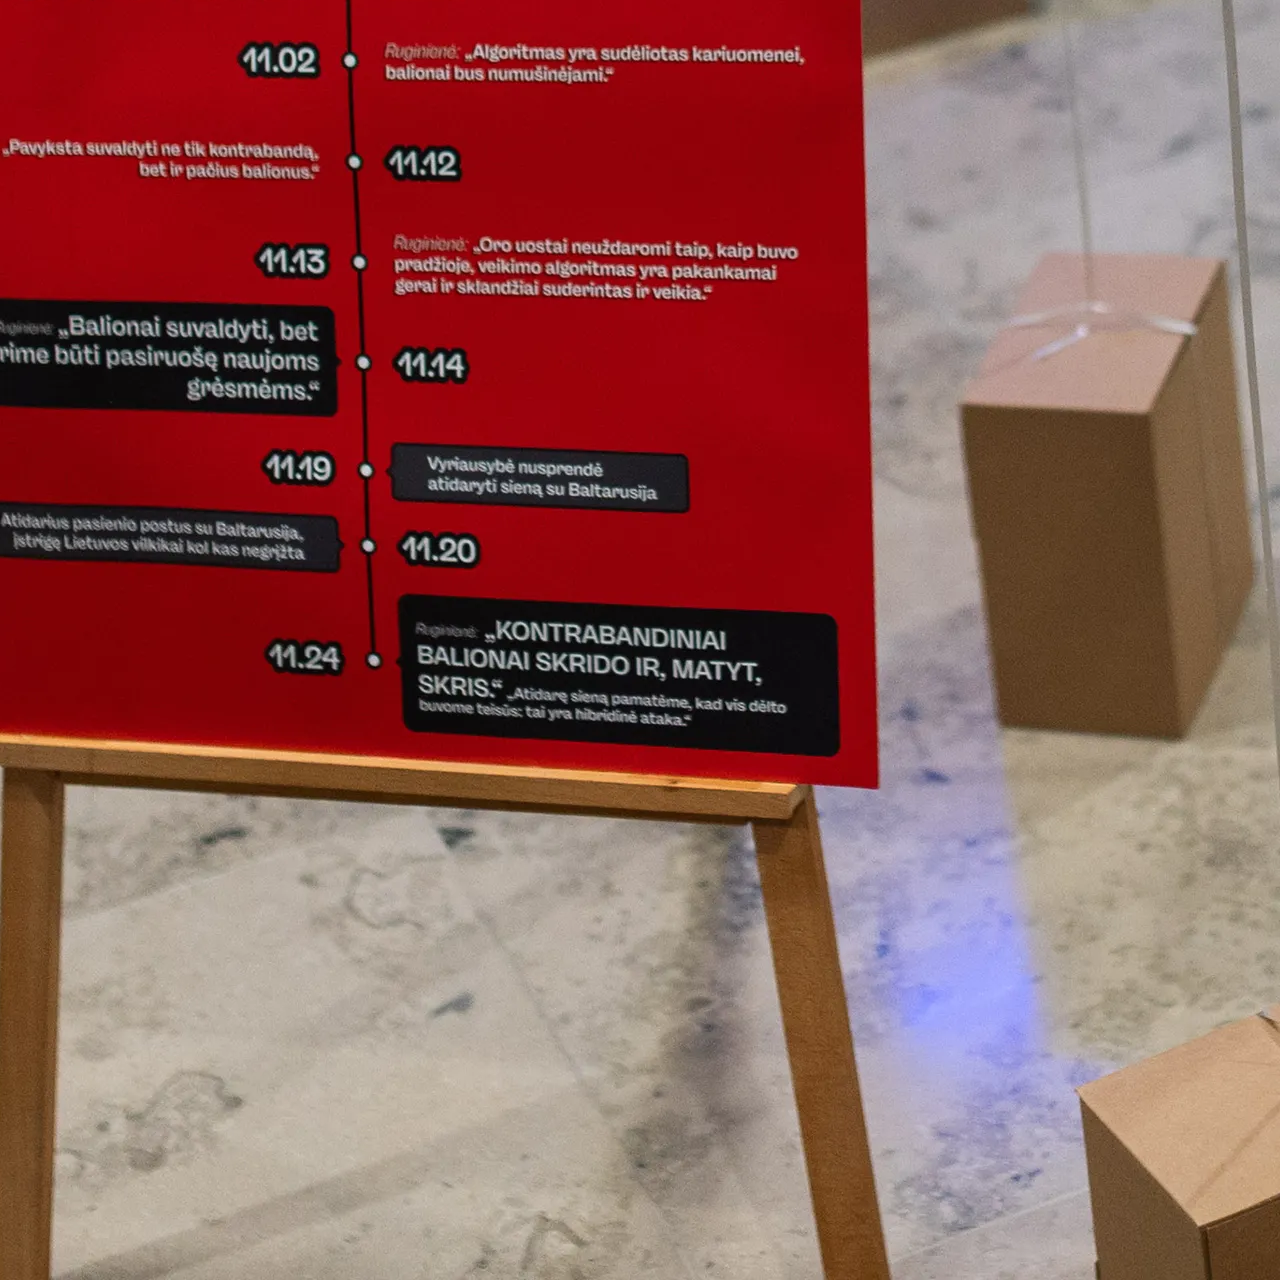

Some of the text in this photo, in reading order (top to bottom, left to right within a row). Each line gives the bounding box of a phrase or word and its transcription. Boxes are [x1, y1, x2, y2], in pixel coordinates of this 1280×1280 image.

[243, 48, 316, 74] 11.02
[568, 48, 597, 62] yra
[600, 45, 688, 62] sudėliotas
[692, 46, 804, 65] kariuomenei,
[385, 65, 450, 80] balionai
[454, 65, 484, 81] bus
[86, 140, 157, 158] suvaldyti
[161, 144, 180, 157] ne
[184, 141, 205, 158] tik
[140, 162, 166, 177] bet
[170, 163, 183, 177] ir
[187, 162, 238, 180] pačius
[389, 150, 457, 176] 11.12
[260, 248, 325, 274] 11.13
[515, 238, 568, 255] uostai
[572, 239, 671, 257] neuždaromi
[675, 241, 713, 260] taip,
[717, 242, 753, 261] kaip
[757, 243, 798, 260] buvo
[394, 258, 776, 281] pradžioje, veikimo algoritmas yra pakankamai
[394, 279, 437, 296] gerai
[440, 279, 453, 294] ir
[457, 279, 538, 296] sklandžiai
[543, 281, 632, 298] suderintas
[636, 284, 649, 299] ir
[166, 319, 275, 344] suvaldyti,
[280, 321, 318, 340] bet
[55, 344, 100, 365] būti
[106, 347, 218, 370] pasiruošę
[223, 352, 319, 372] naujoms
[397, 353, 464, 379] 11.14
[266, 455, 331, 480] 11.19
[427, 456, 603, 481] Vyriausybė nusprendė
[427, 477, 497, 494] atidaryti
[547, 482, 565, 496] su
[569, 483, 658, 502] Baltarusija
[73, 516, 136, 533] pasienio
[140, 518, 191, 535] postus
[195, 523, 213, 534] su
[216, 522, 304, 542] Baltarusija,
[64, 535, 128, 552] Lietuvos
[132, 537, 183, 553] vilkikai
[186, 540, 209, 555] kol
[212, 541, 239, 556] kas
[402, 537, 476, 563] 11.20
[268, 644, 340, 671] 11.24
[417, 645, 762, 685] BALIONAI SKRIDO IR, MATYT,
[419, 699, 473, 716] buvome
[525, 704, 545, 718] tai
[549, 708, 573, 722] yra
[576, 706, 638, 724] hibridinė
[612, 692, 691, 712] pamatėme,
[695, 698, 722, 712] kad
[725, 699, 746, 713] vis
[749, 699, 786, 714] dėlto
